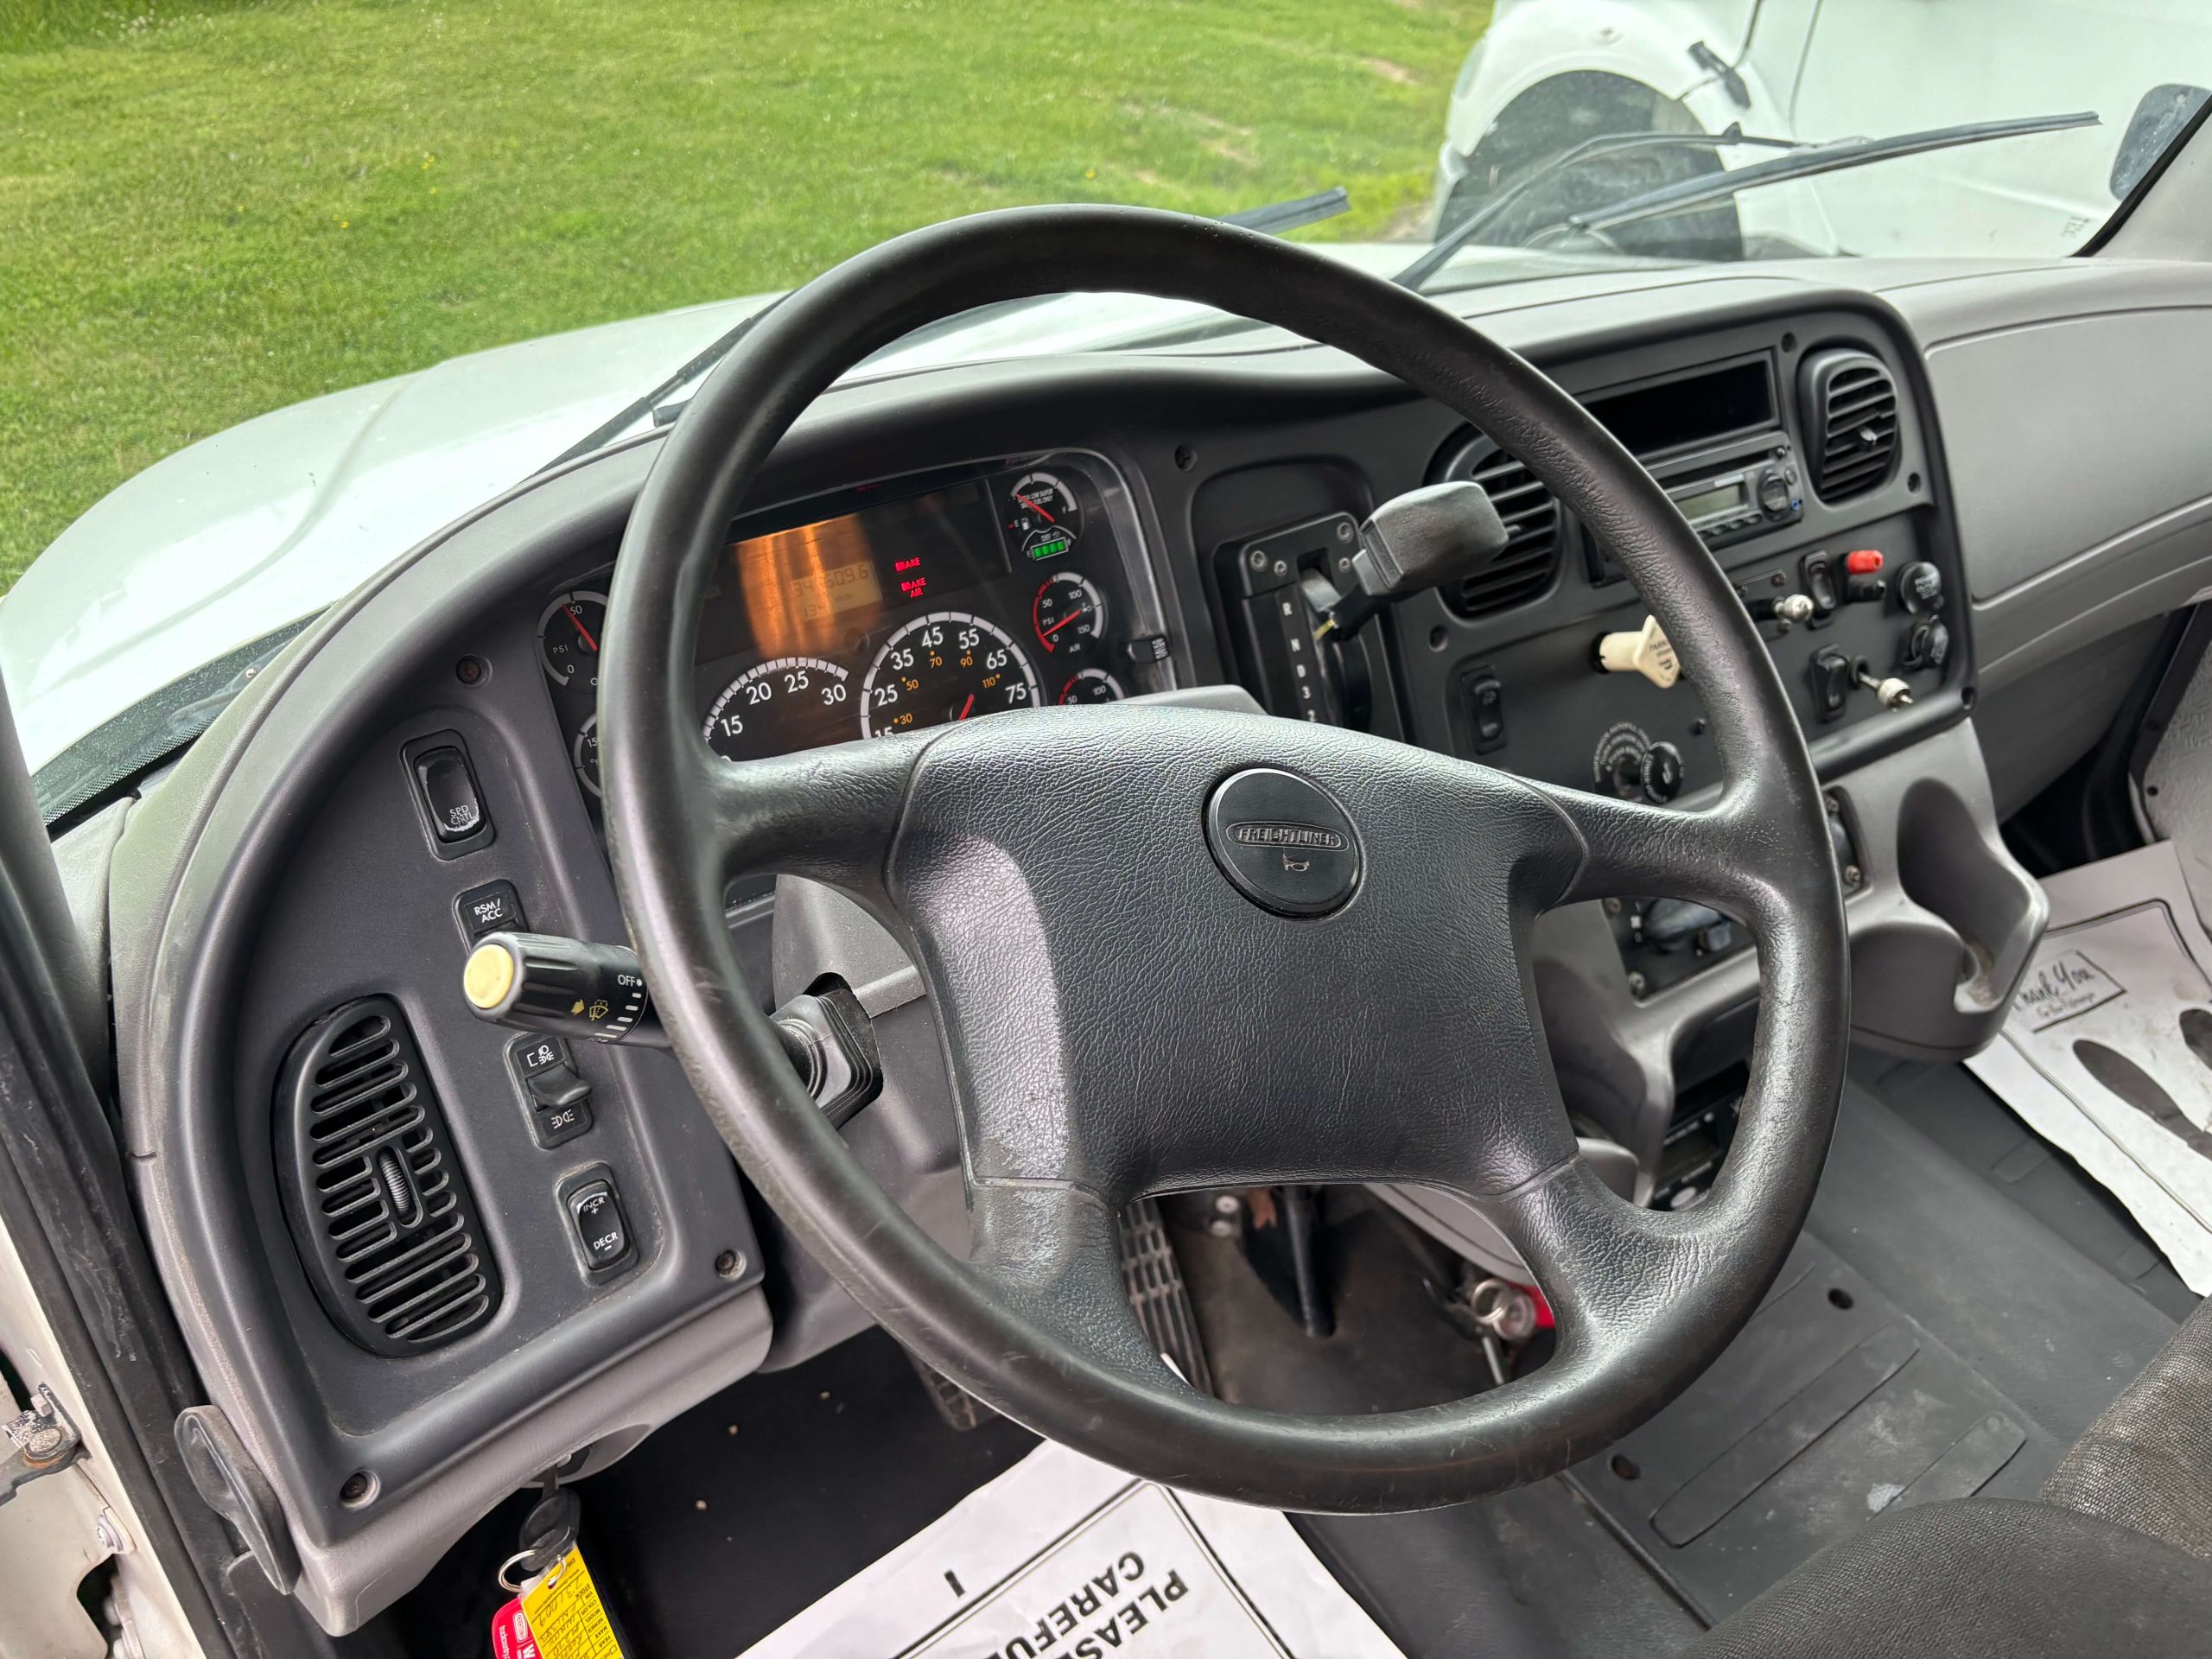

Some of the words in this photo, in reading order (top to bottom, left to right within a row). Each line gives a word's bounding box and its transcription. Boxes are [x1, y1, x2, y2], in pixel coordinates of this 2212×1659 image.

[894, 557, 921, 572] BRAKE
[900, 577, 926, 593] BRAKE
[911, 588, 924, 598] AIR
[1068, 589, 1082, 600] 100
[1042, 598, 1052, 608] 50
[1282, 602, 1293, 616] R
[569, 605, 583, 616] 50
[1042, 617, 1054, 626] PSI
[1077, 624, 1090, 634] 150
[921, 626, 944, 648] 45
[958, 628, 980, 649] 55
[553, 645, 569, 654] PSI
[1069, 644, 1080, 653] AIR
[1291, 638, 1300, 652] N
[891, 648, 914, 671] 35
[929, 656, 943, 669] 70
[960, 655, 973, 668] 90
[986, 649, 1007, 670] 65
[567, 664, 575, 674] 0
[1297, 664, 1306, 678] D
[785, 671, 809, 693] 25
[906, 678, 918, 691] 50
[982, 676, 996, 689] 110
[747, 682, 772, 705] 20
[822, 683, 847, 706] 30
[874, 683, 899, 707] 25
[1005, 682, 1027, 704] 75
[1093, 685, 1107, 696] 100
[1302, 686, 1311, 699] 3
[1067, 695, 1078, 704] 50
[721, 715, 743, 737] 15
[899, 713, 912, 725] 30
[449, 804, 469, 817] SPD
[450, 811, 475, 825] CNTL
[1238, 827, 1337, 847] FREIGHTLINER
[474, 898, 501, 916] RSM/
[481, 908, 503, 924] ACC
[618, 974, 636, 987] OFF
[2052, 959, 2096, 991] You
[583, 1197, 605, 1213] INCR
[593, 1231, 618, 1250] DECR
[575, 1583, 591, 1598] STOCK
[582, 1599, 597, 1615] COLOR
[987, 1551, 1145, 1659] CAREFU
[586, 1608, 601, 1623] MODEL
[1058, 1568, 1189, 1659] PLEAS
[595, 1625, 607, 1639] MAKE
[599, 1635, 611, 1648] YEAR
